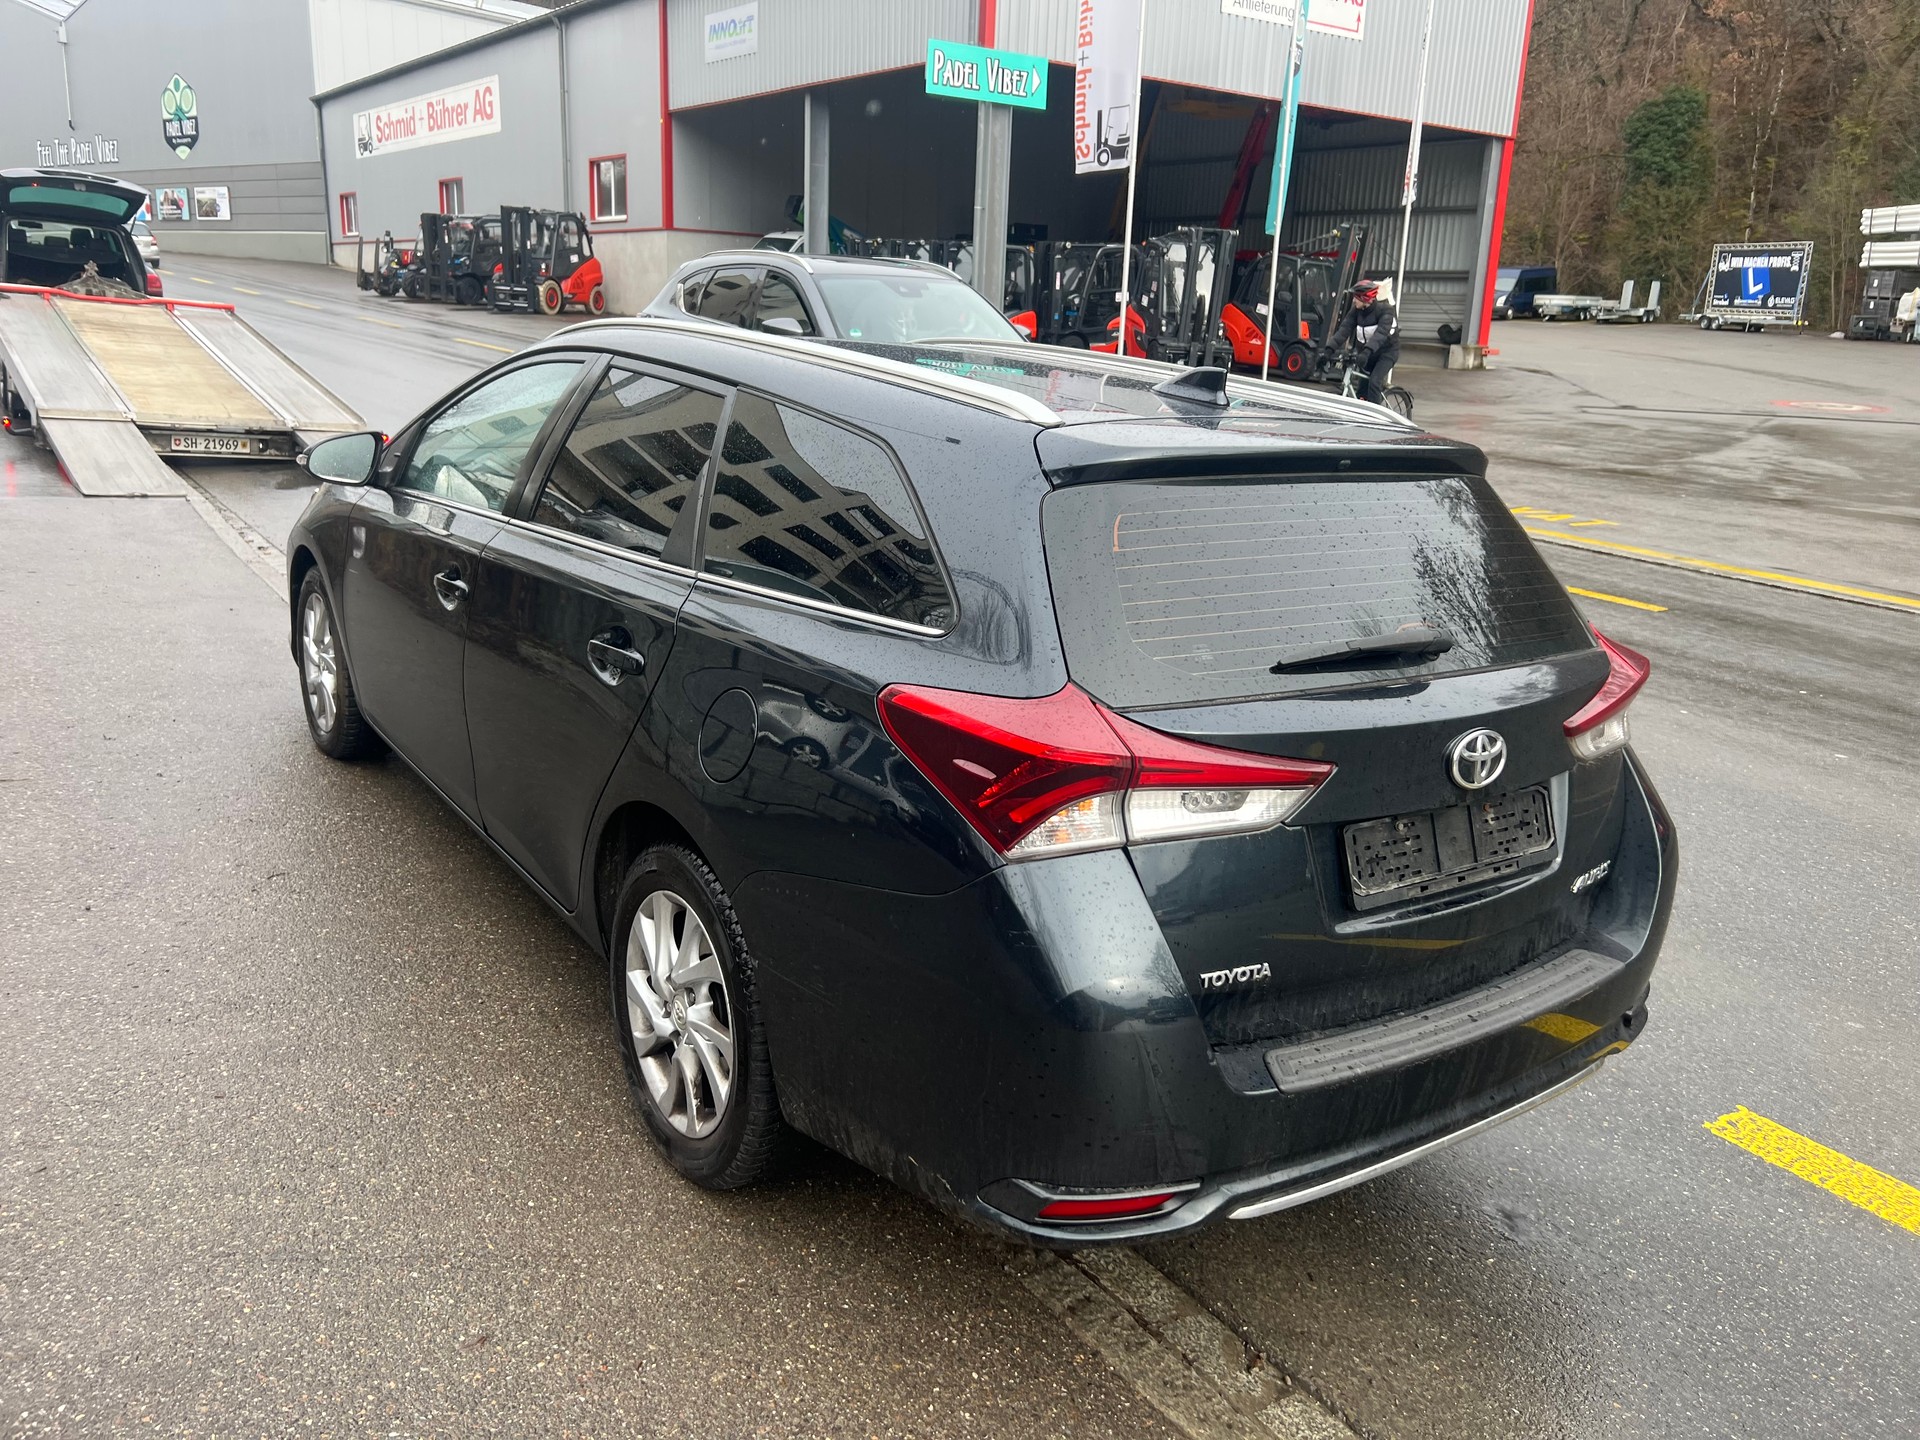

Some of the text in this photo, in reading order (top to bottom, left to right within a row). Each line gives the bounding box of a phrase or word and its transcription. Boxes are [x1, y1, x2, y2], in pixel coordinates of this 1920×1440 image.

[932, 48, 1029, 98] PADEL VIBEZ
[375, 106, 417, 144] Schmid
[426, 98, 469, 133] Bührer
[473, 86, 494, 123] AG
[1200, 962, 1272, 989] TOYOTA
